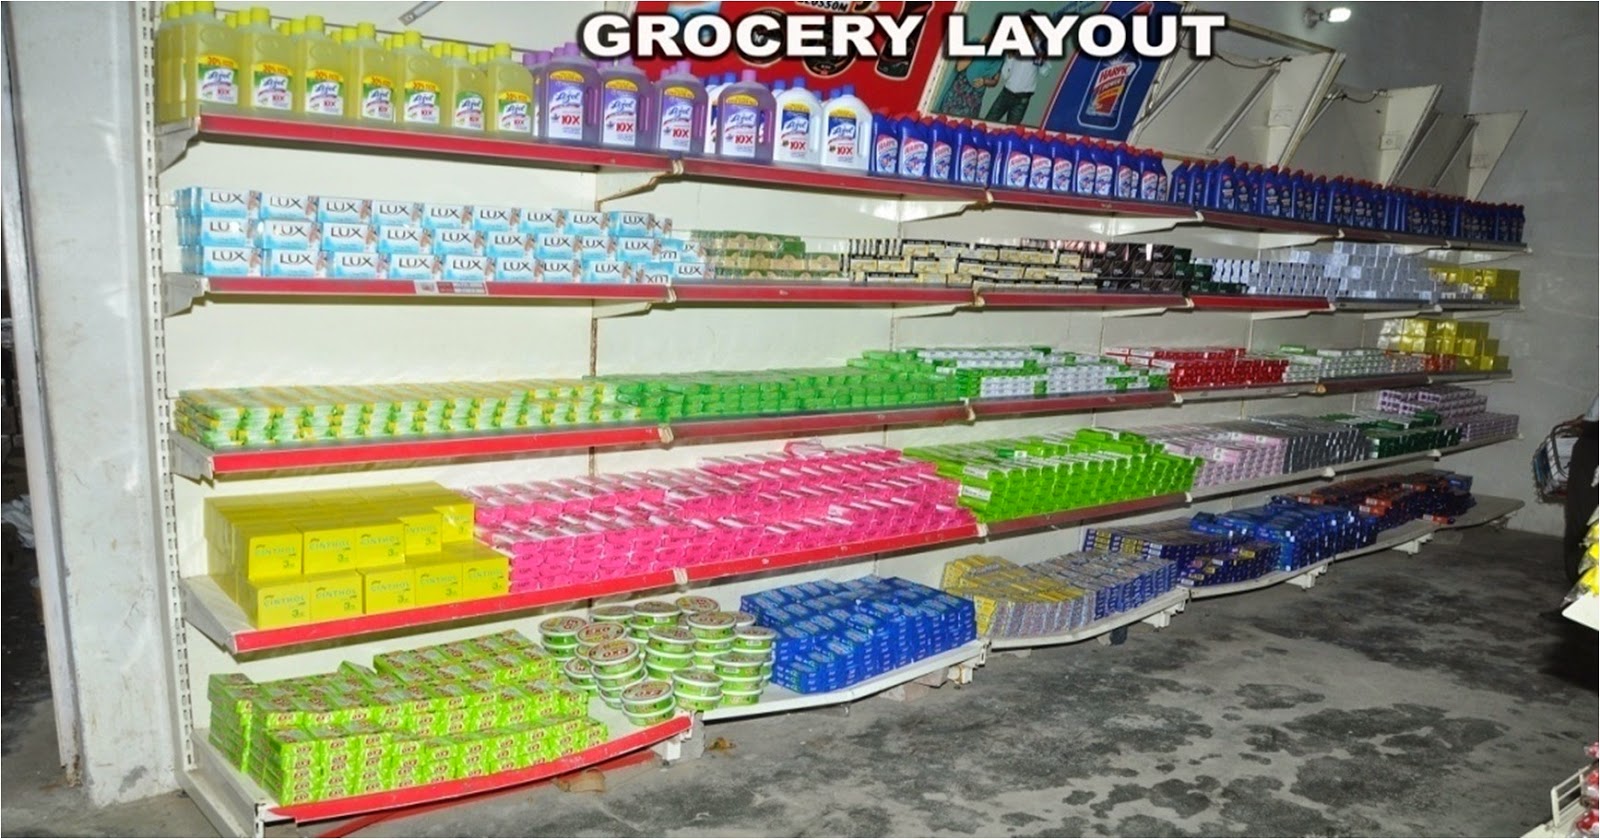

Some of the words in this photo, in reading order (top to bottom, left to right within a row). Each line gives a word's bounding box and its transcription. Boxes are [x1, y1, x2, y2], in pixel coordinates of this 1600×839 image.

[561, 115, 580, 125] 10X
[616, 122, 634, 132] 10X
[672, 128, 689, 138] 10X
[735, 135, 753, 144] 10X
[790, 141, 806, 150] 10X
[837, 146, 853, 155] 10X
[210, 191, 245, 204] LUX
[270, 196, 304, 209] LUX
[326, 201, 358, 213] LUX
[379, 204, 410, 216] LUX
[430, 207, 460, 219] LUX
[480, 210, 509, 220] LUX
[527, 212, 555, 222] LUX
[573, 214, 599, 224] LUX
[623, 215, 646, 225] LUX
[330, 227, 363, 238] LUX
[387, 230, 418, 241] LUX
[442, 232, 472, 243] LUX
[494, 235, 522, 245] LUX
[544, 237, 572, 247] LUX
[625, 240, 651, 251] LUX
[212, 250, 248, 262] LUX
[280, 253, 314, 265] LUX
[342, 256, 374, 268] LUX
[399, 258, 430, 269] LUX
[453, 259, 483, 270] LUX
[503, 261, 532, 272] LUX
[544, 262, 571, 272] LUX
[595, 263, 620, 273] LUX
[678, 265, 702, 275] LUX
